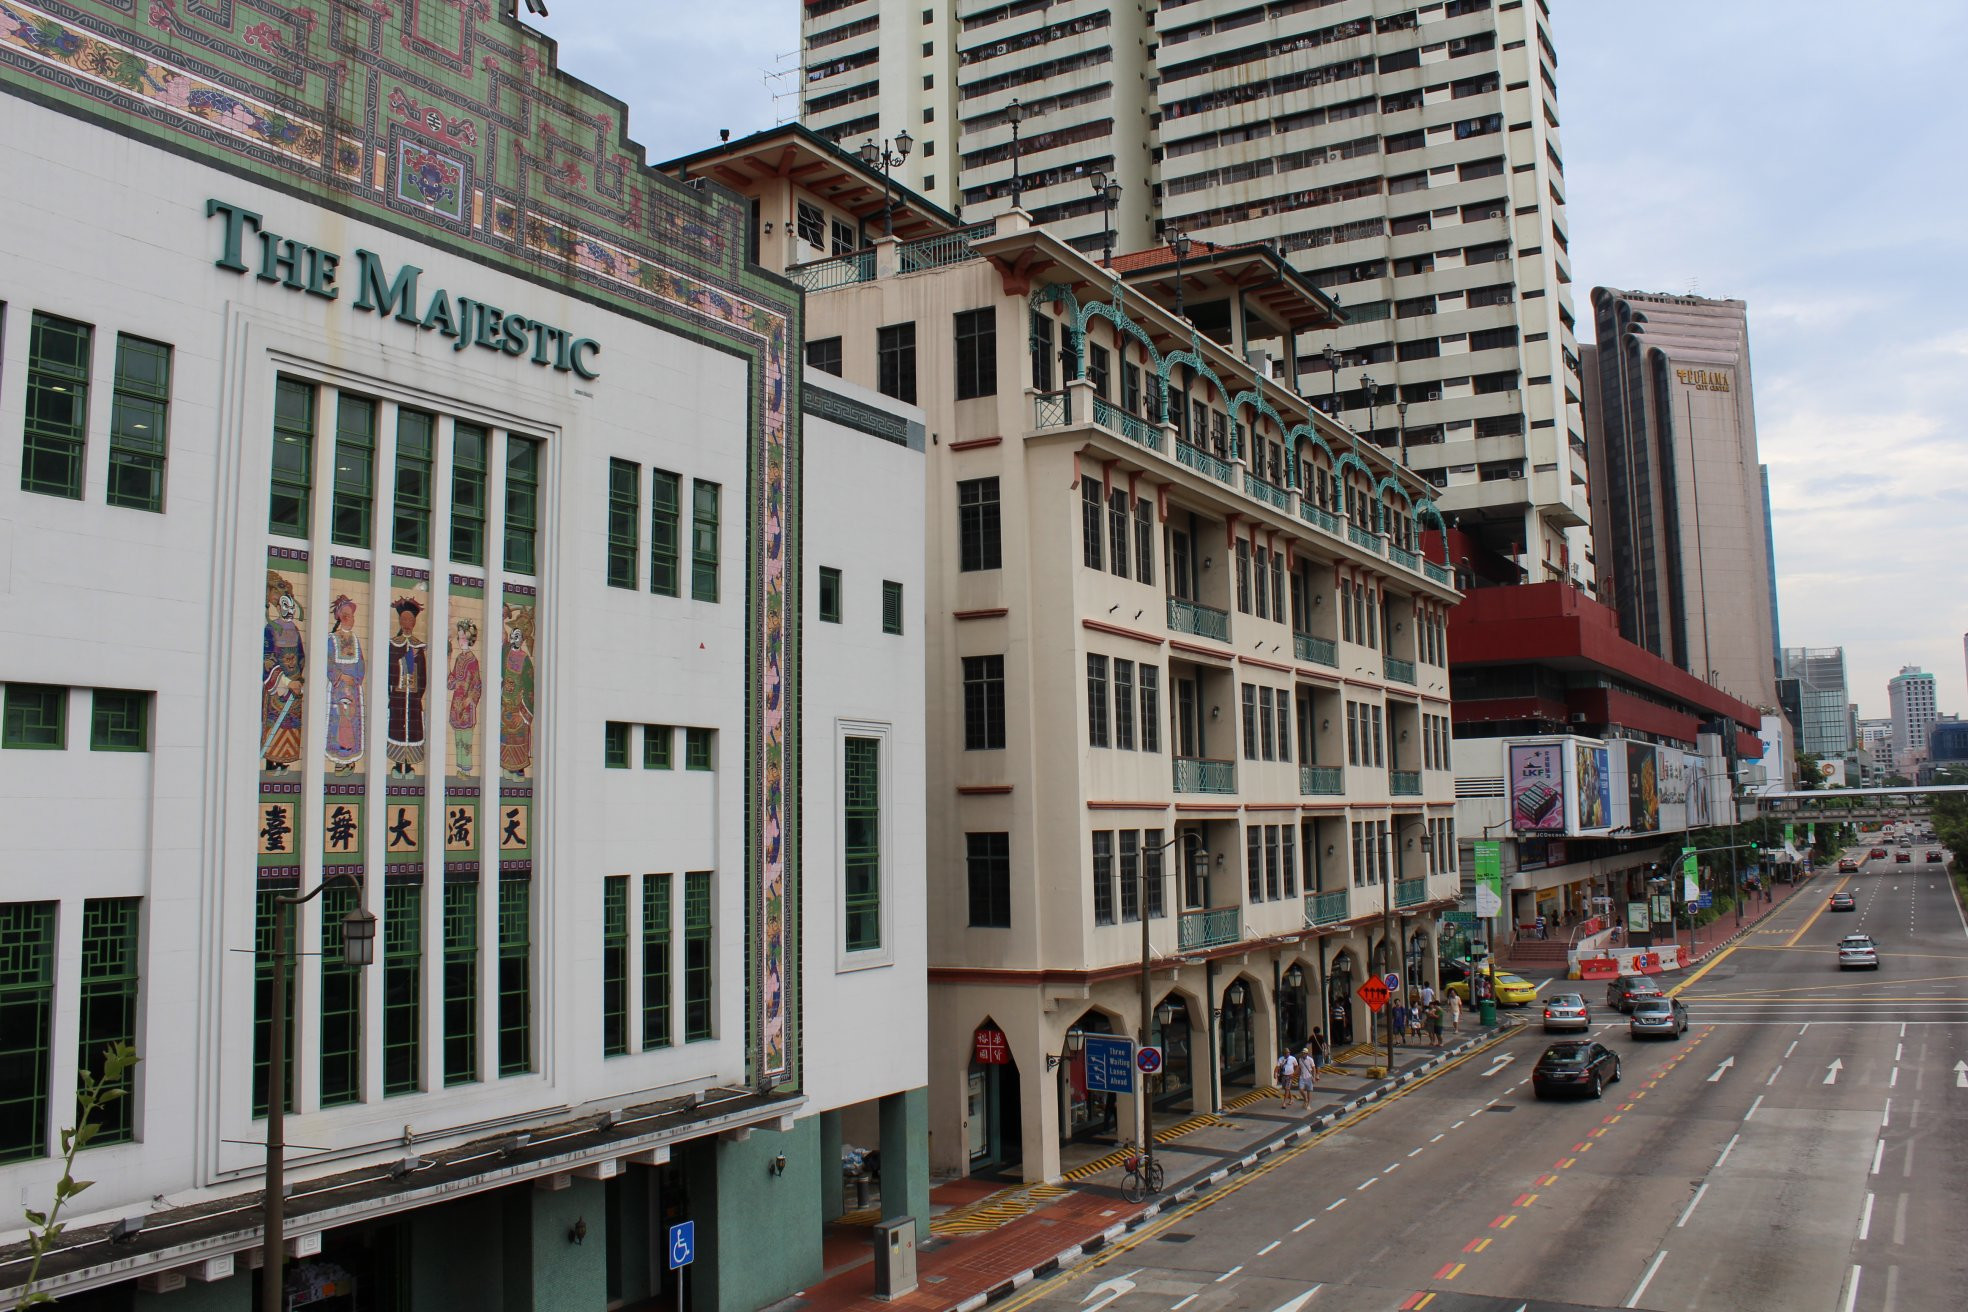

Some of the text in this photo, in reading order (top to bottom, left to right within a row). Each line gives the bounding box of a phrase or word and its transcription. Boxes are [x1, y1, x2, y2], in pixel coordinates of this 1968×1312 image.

[353, 248, 601, 380] MAJESTIC
[1109, 1047, 1125, 1056] Three
[1109, 1057, 1131, 1069] Waiting
[1109, 1067, 1126, 1076] Lanes
[1110, 1077, 1128, 1086] Ahead
